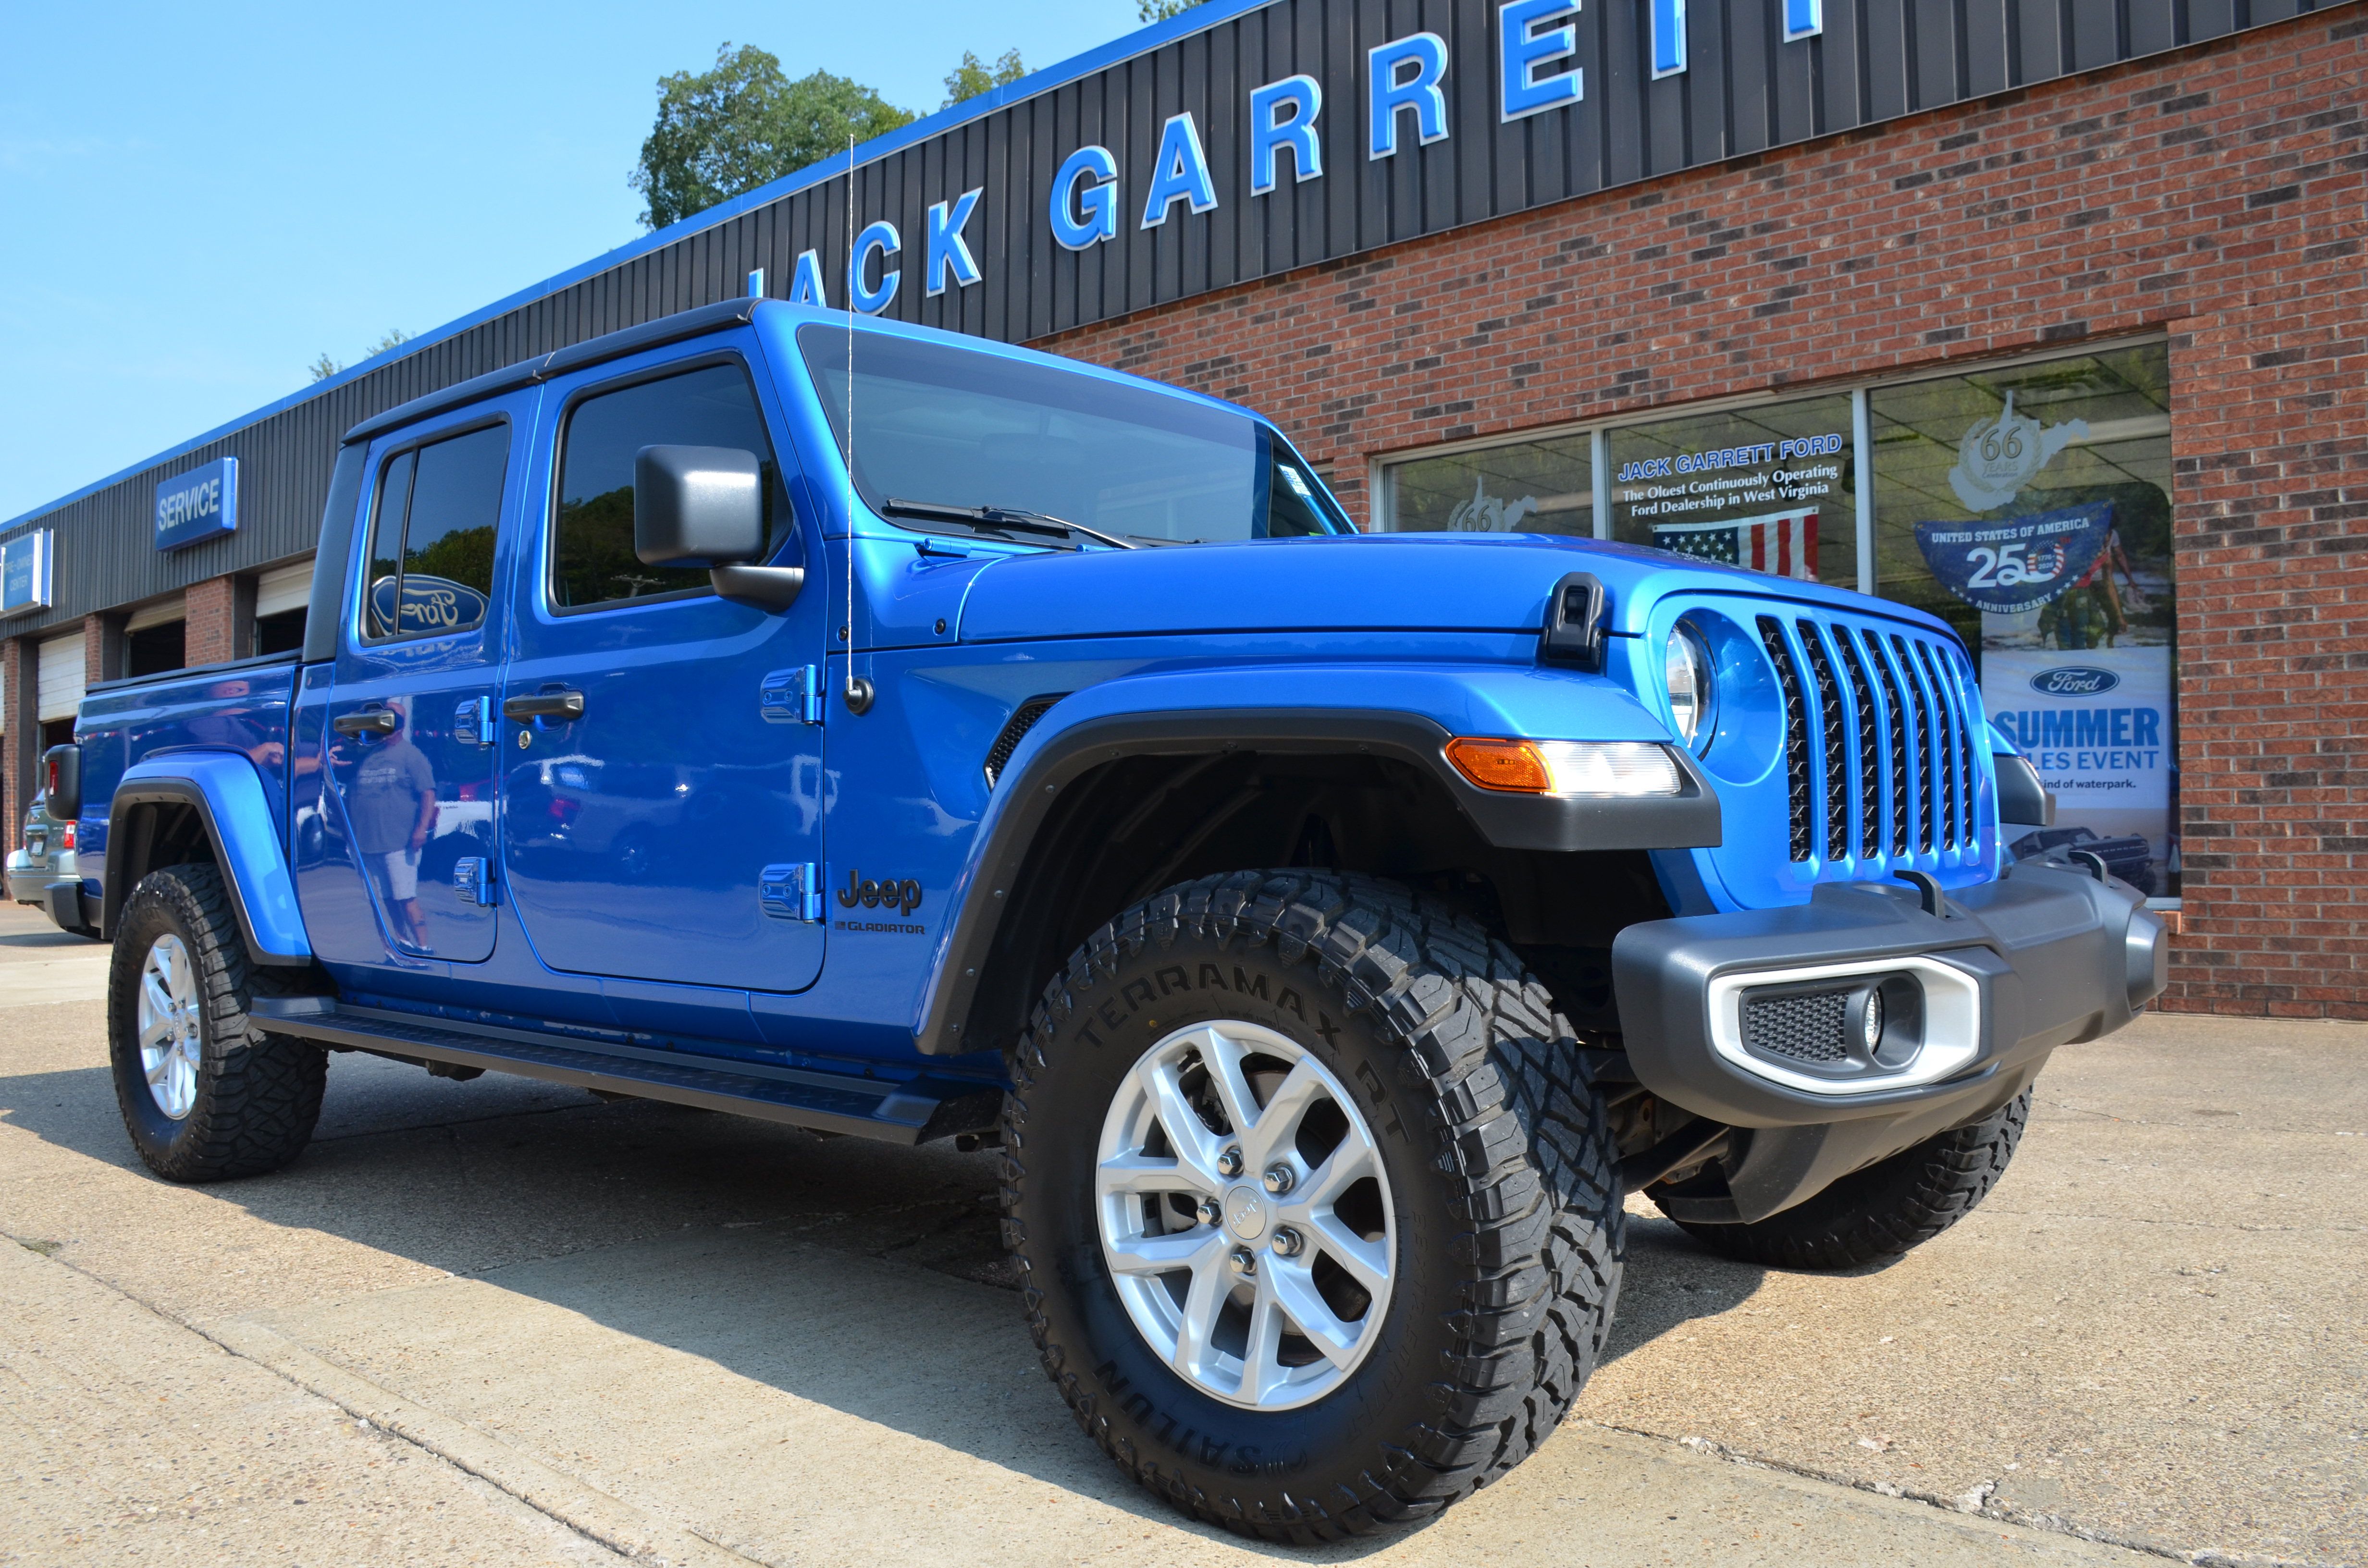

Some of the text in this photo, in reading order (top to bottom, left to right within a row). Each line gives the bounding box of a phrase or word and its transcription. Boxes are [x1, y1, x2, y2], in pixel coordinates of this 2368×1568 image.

[1049, 0, 1822, 251] GARRE
[1618, 433, 1842, 482] JACK GARRETT FORD
[1980, 426, 2023, 461] 66
[1623, 490, 1644, 502] The
[1689, 474, 1769, 494] Continuously
[1773, 464, 1838, 484] Operating
[1631, 483, 1829, 516] Ford Dealership in West Virginia
[158, 478, 220, 531] SERVICE
[1462, 505, 1492, 532] 66
[1932, 517, 2090, 543] UNITED STATES OF AMERICA
[1966, 540, 2065, 588] 250
[1975, 593, 2052, 614] ANNIVERSARY
[2047, 672, 2101, 692] Ford
[1994, 708, 2159, 748] SUMMER
[2077, 750, 2159, 770] EVENT
[2041, 779, 2136, 790] ind of waterpark.
[837, 869, 921, 916] Jeep
[848, 921, 925, 934] GLADIATOR
[1074, 962, 1411, 1145] TERRAMAX RT
[1092, 1359, 1264, 1476] SAILUN
